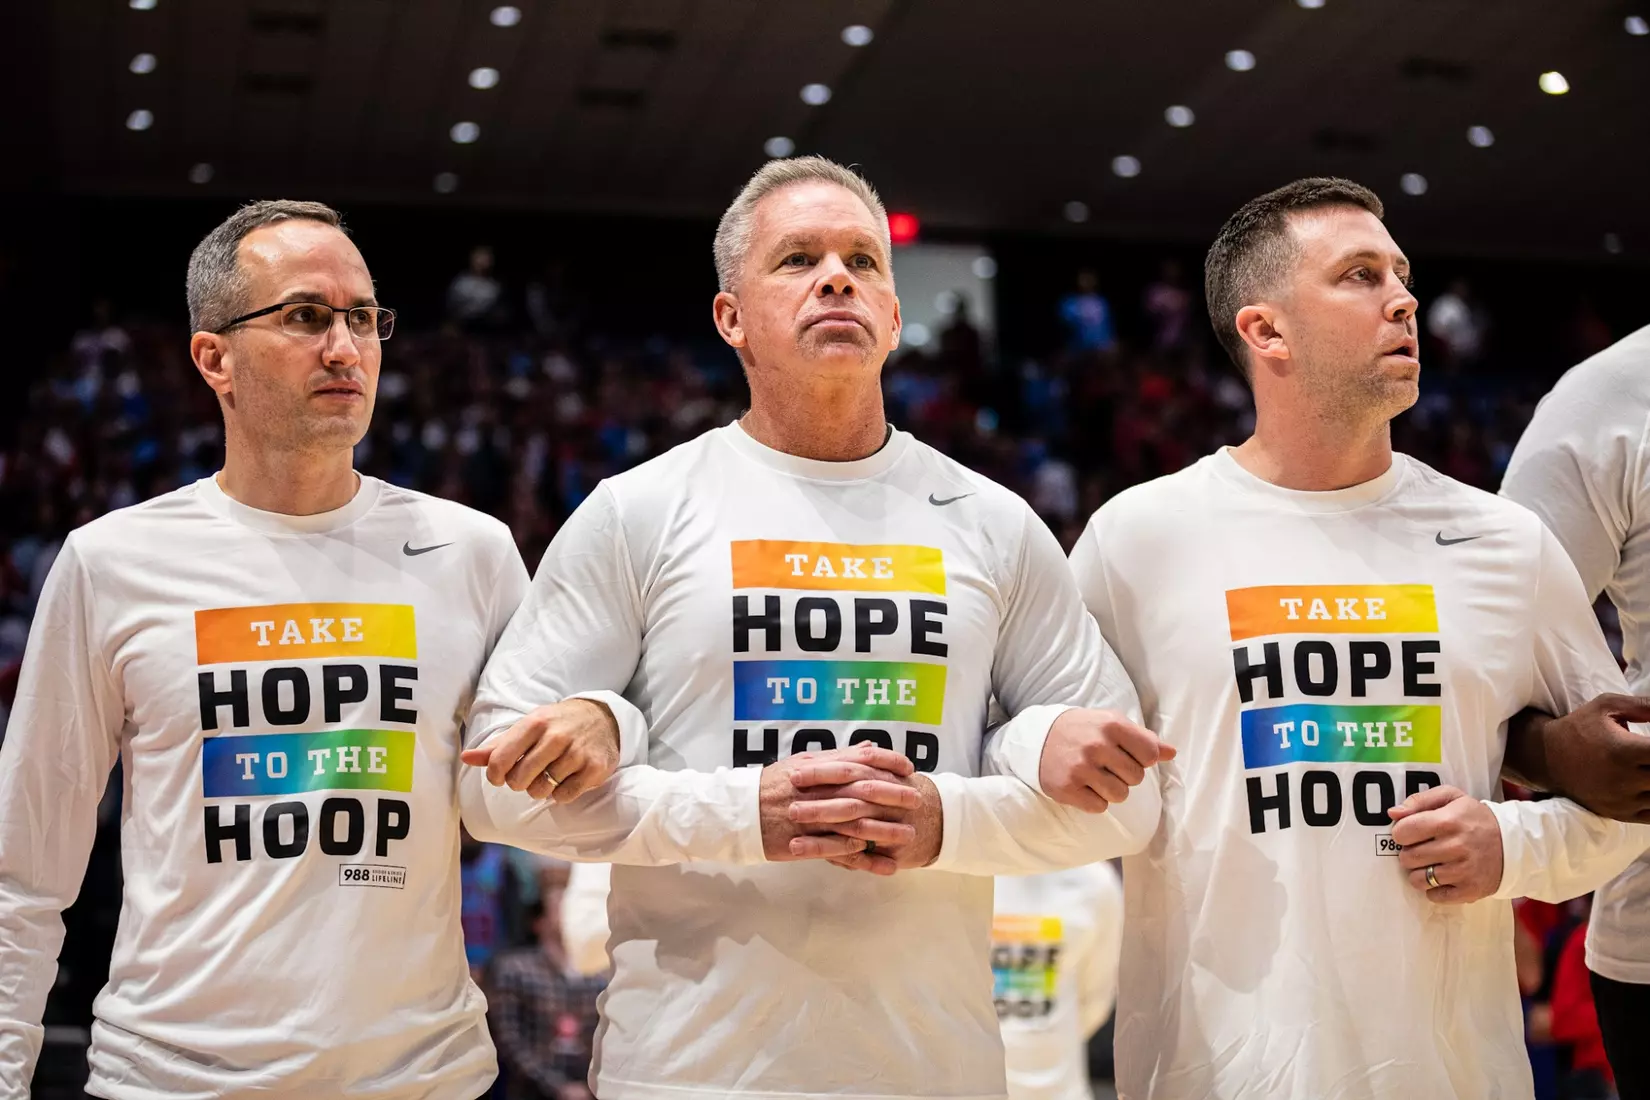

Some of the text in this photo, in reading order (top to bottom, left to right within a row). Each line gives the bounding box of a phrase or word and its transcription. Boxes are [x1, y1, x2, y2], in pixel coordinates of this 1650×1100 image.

[784, 553, 894, 579] TAKE
[1279, 597, 1387, 620] TAKE
[250, 617, 364, 646] TAKE
[732, 595, 948, 658] HOPE
[1232, 640, 1442, 704] HOPE
[198, 664, 419, 731] HOPE
[766, 677, 917, 706] TO THE
[1272, 720, 1413, 749] TO THE
[235, 746, 388, 780] TO THE
[203, 797, 410, 864] HOOP
[344, 868, 370, 881] 988
